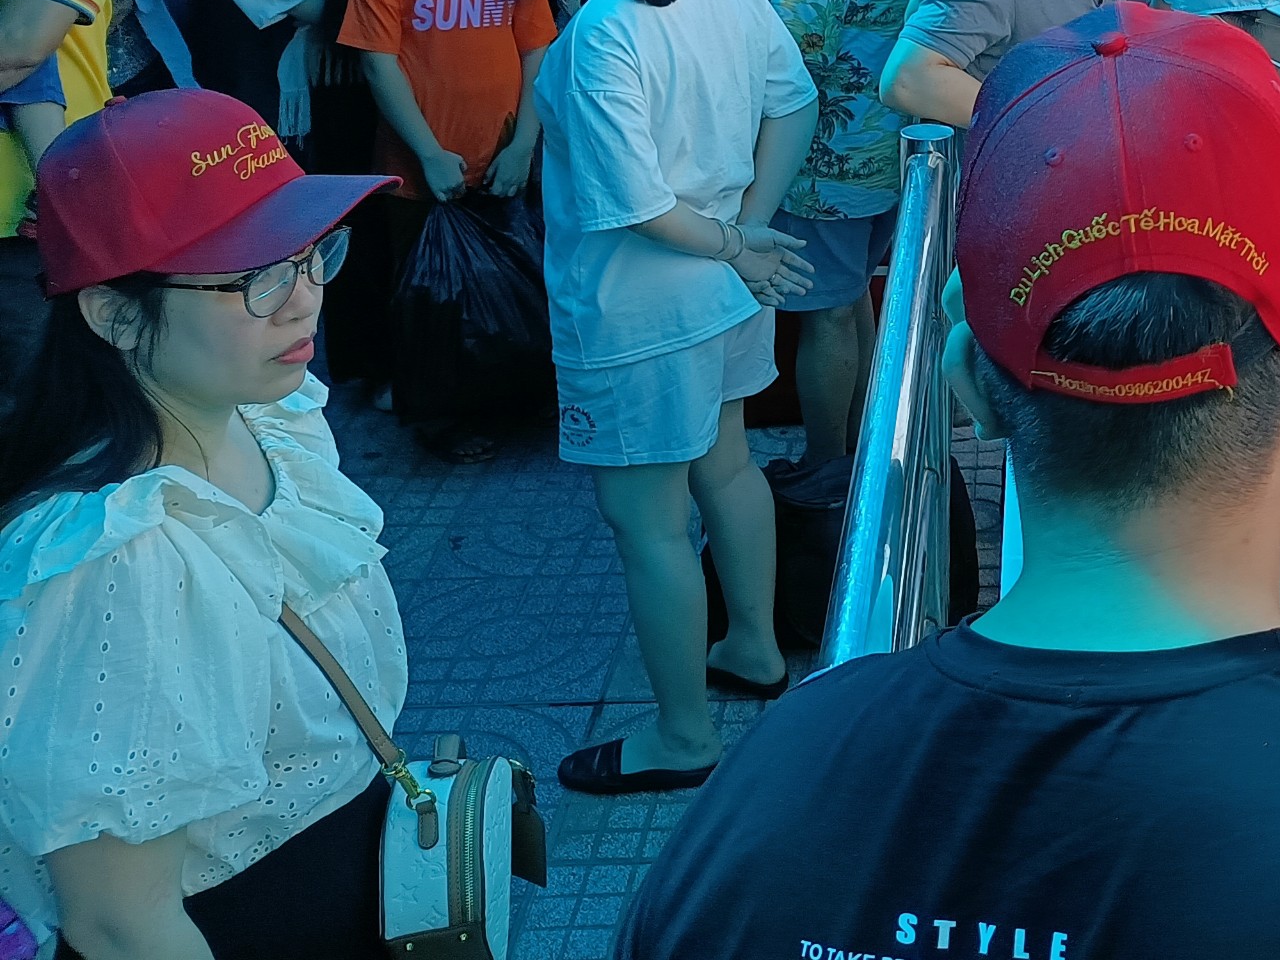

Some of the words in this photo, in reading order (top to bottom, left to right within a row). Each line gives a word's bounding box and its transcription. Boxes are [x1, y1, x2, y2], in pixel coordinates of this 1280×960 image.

[190, 143, 236, 177] Sun
[1009, 277, 1034, 307] Du
[1023, 242, 1065, 280] Lịch
[1062, 212, 1121, 250] Quốc
[1122, 206, 1157, 233] Tế
[1159, 211, 1200, 235] Hoa
[1200, 216, 1241, 250] Mặt
[800, 939, 823, 960] TO
[895, 912, 1068, 960] STYLE
